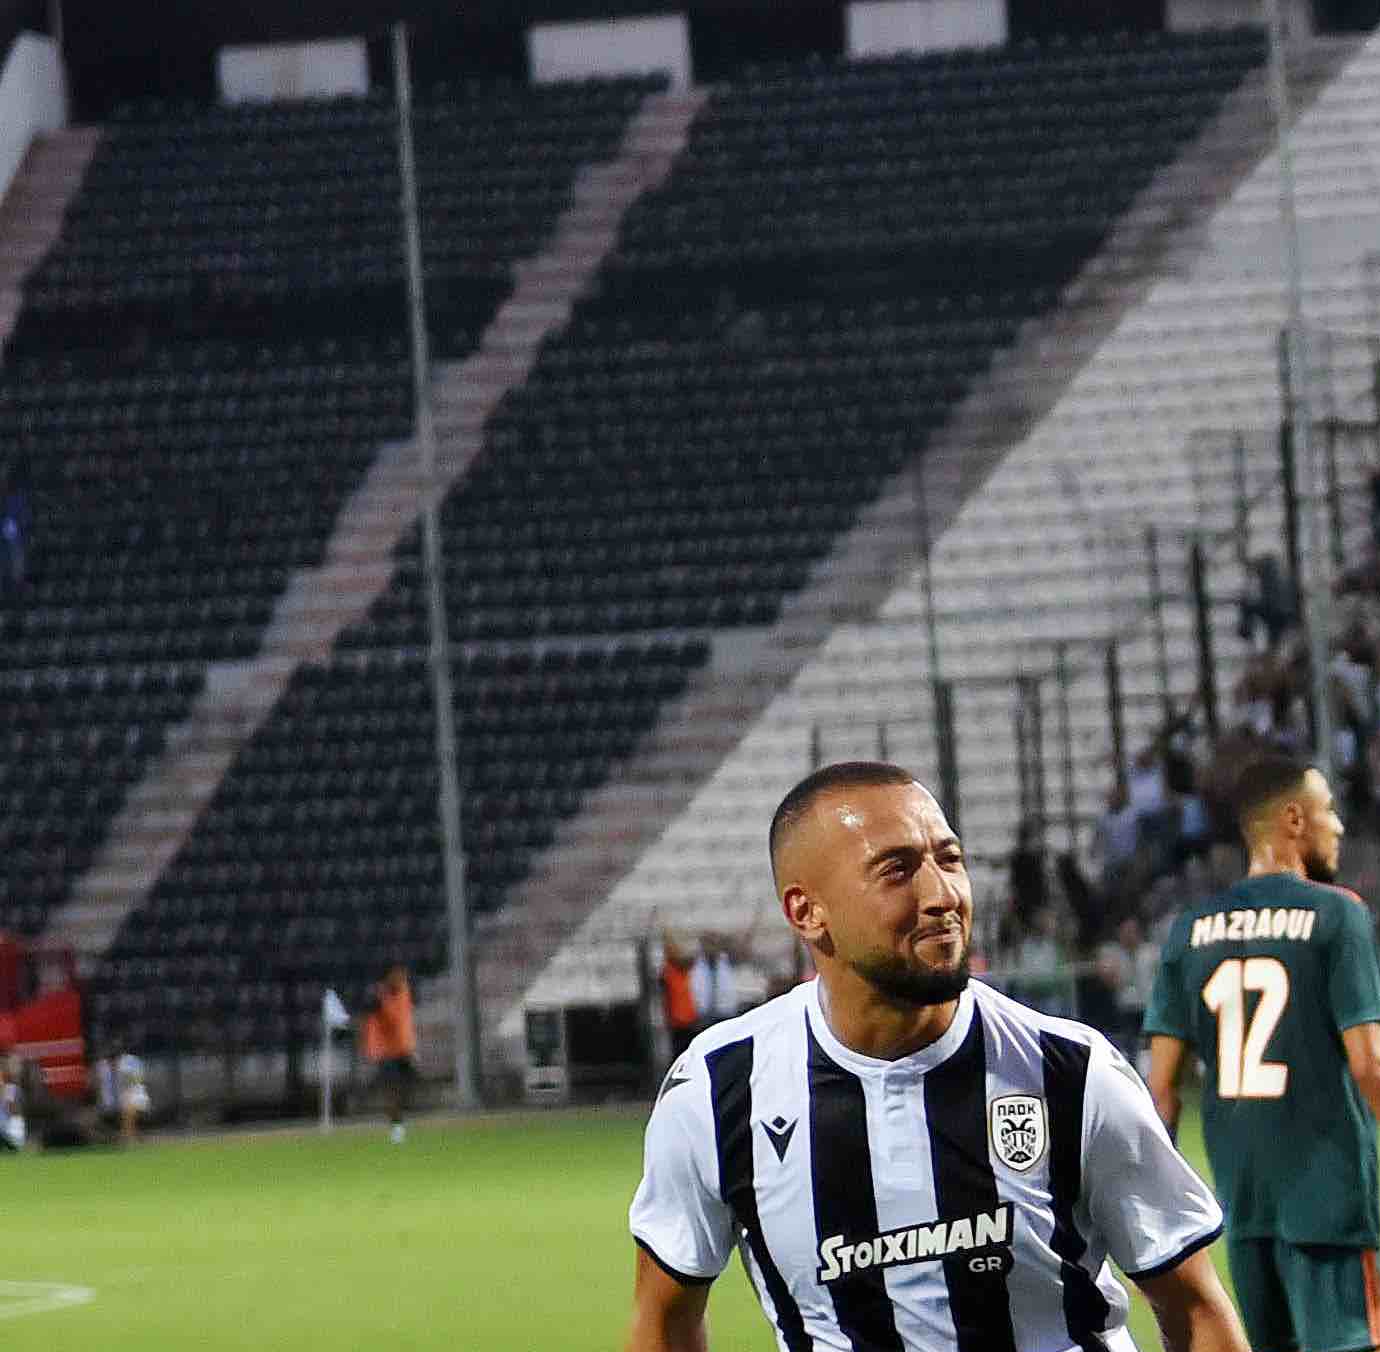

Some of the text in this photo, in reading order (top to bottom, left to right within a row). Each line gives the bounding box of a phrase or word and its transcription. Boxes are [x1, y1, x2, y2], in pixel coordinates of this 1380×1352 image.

[1190, 907, 1317, 948] MAZRAOUI
[1202, 955, 1291, 1100] 12
[968, 1256, 1002, 1273] GR
